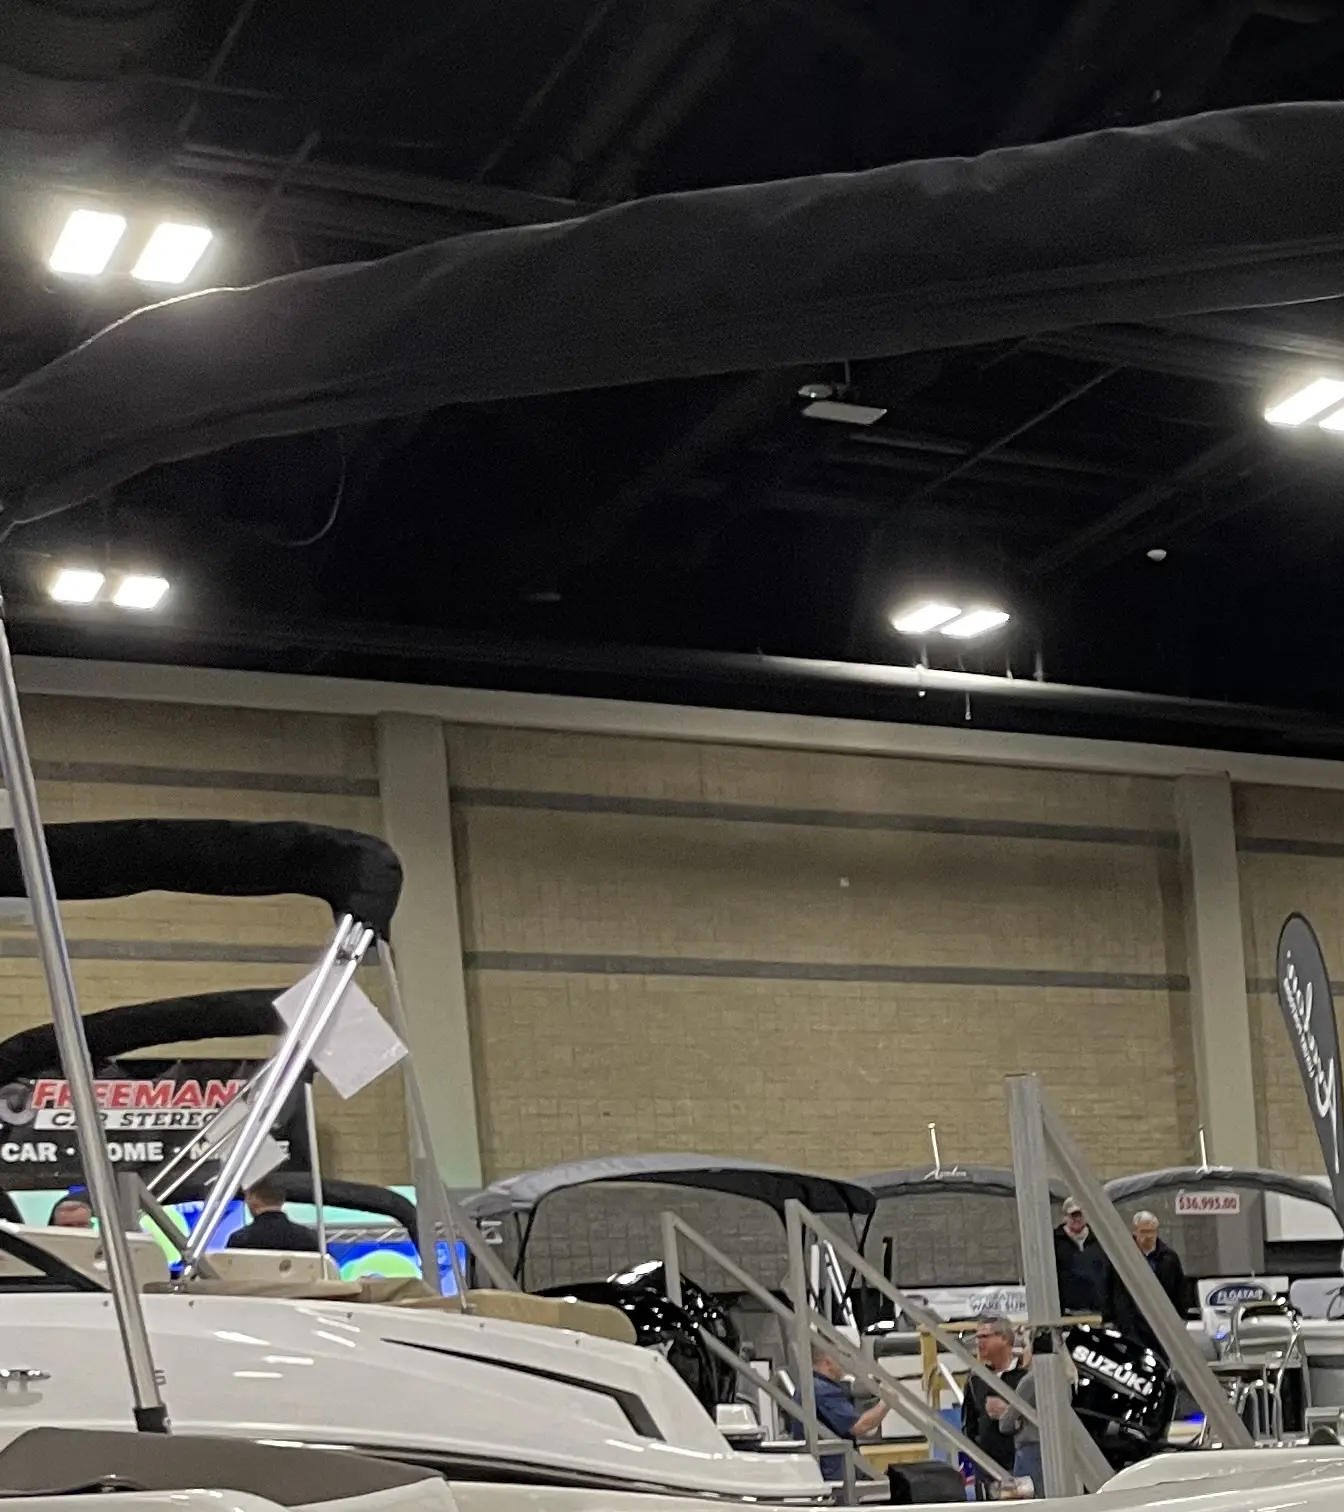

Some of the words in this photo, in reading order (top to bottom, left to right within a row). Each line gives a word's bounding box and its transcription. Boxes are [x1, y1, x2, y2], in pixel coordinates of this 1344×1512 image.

[1, 1142, 58, 1162] CAR
[106, 1142, 164, 1162] OME
[1072, 1345, 1154, 1396] SUZUKI
